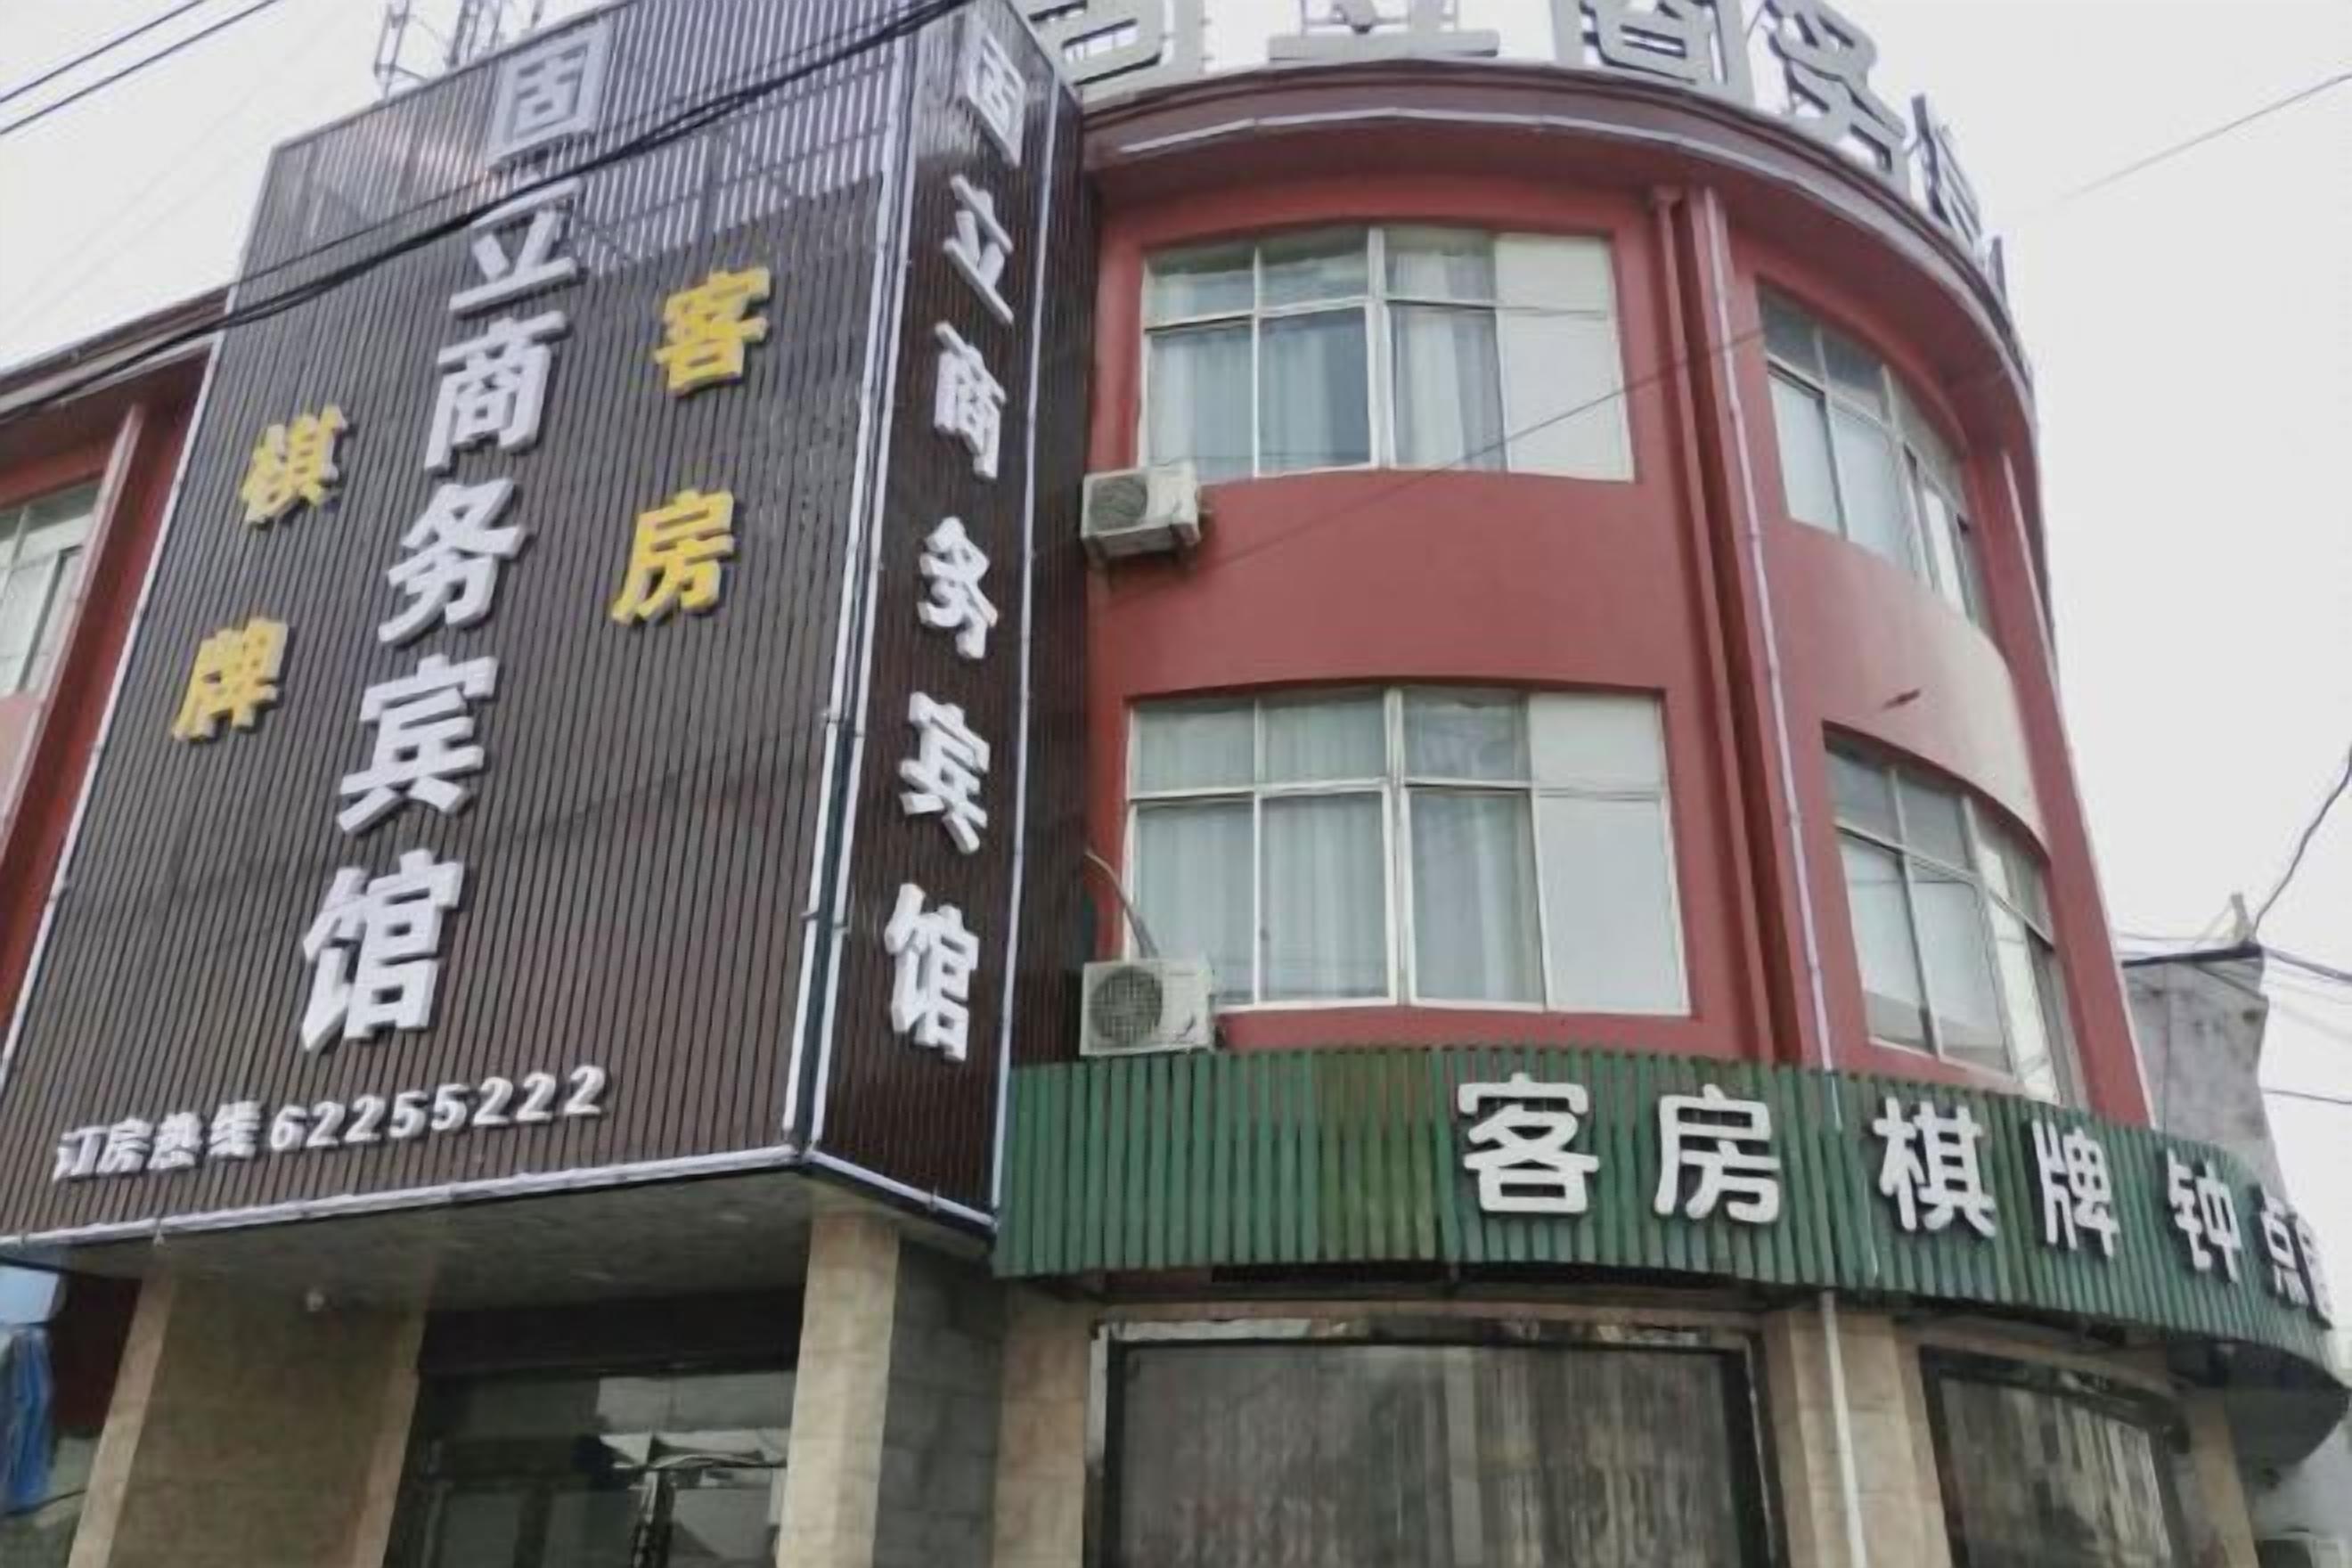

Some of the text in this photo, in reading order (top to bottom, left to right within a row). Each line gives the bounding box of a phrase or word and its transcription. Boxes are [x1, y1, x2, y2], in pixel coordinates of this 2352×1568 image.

[173, 405, 348, 741] 棋牌
[301, 23, 615, 1052] 固立商务宾馆
[610, 267, 771, 625] 客房
[884, 30, 1026, 1062] 固立商务宾馆
